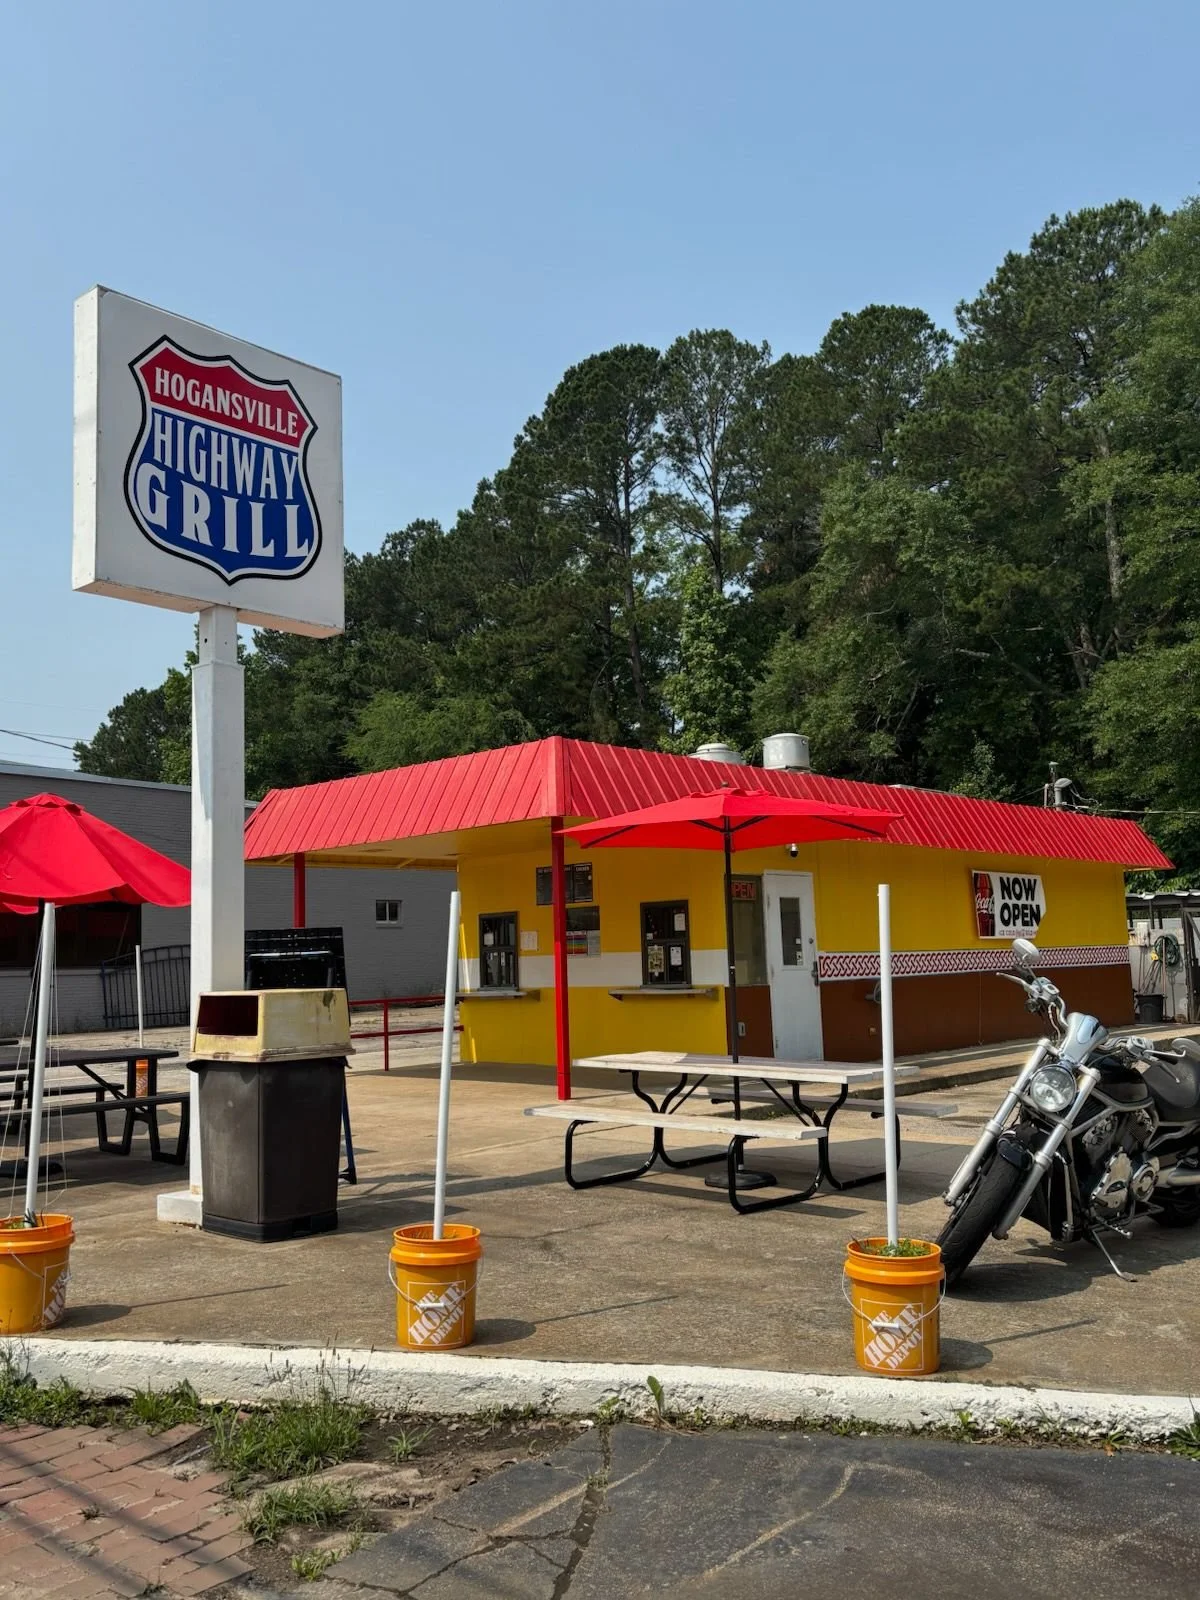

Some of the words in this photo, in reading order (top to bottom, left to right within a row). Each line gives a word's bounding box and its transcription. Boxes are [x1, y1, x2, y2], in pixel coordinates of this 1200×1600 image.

[155, 367, 298, 438] HOGANSVILLE
[153, 412, 298, 500] HIGHWAY
[136, 462, 309, 557] GRILL
[732, 883, 756, 897] PEN
[1000, 877, 1037, 901] NOW
[1000, 903, 1040, 927] OPEN
[409, 1283, 466, 1344] HOME
[430, 1305, 464, 1344] DEPOT
[864, 1304, 922, 1367] HOME
[886, 1329, 922, 1369] DEPOT
